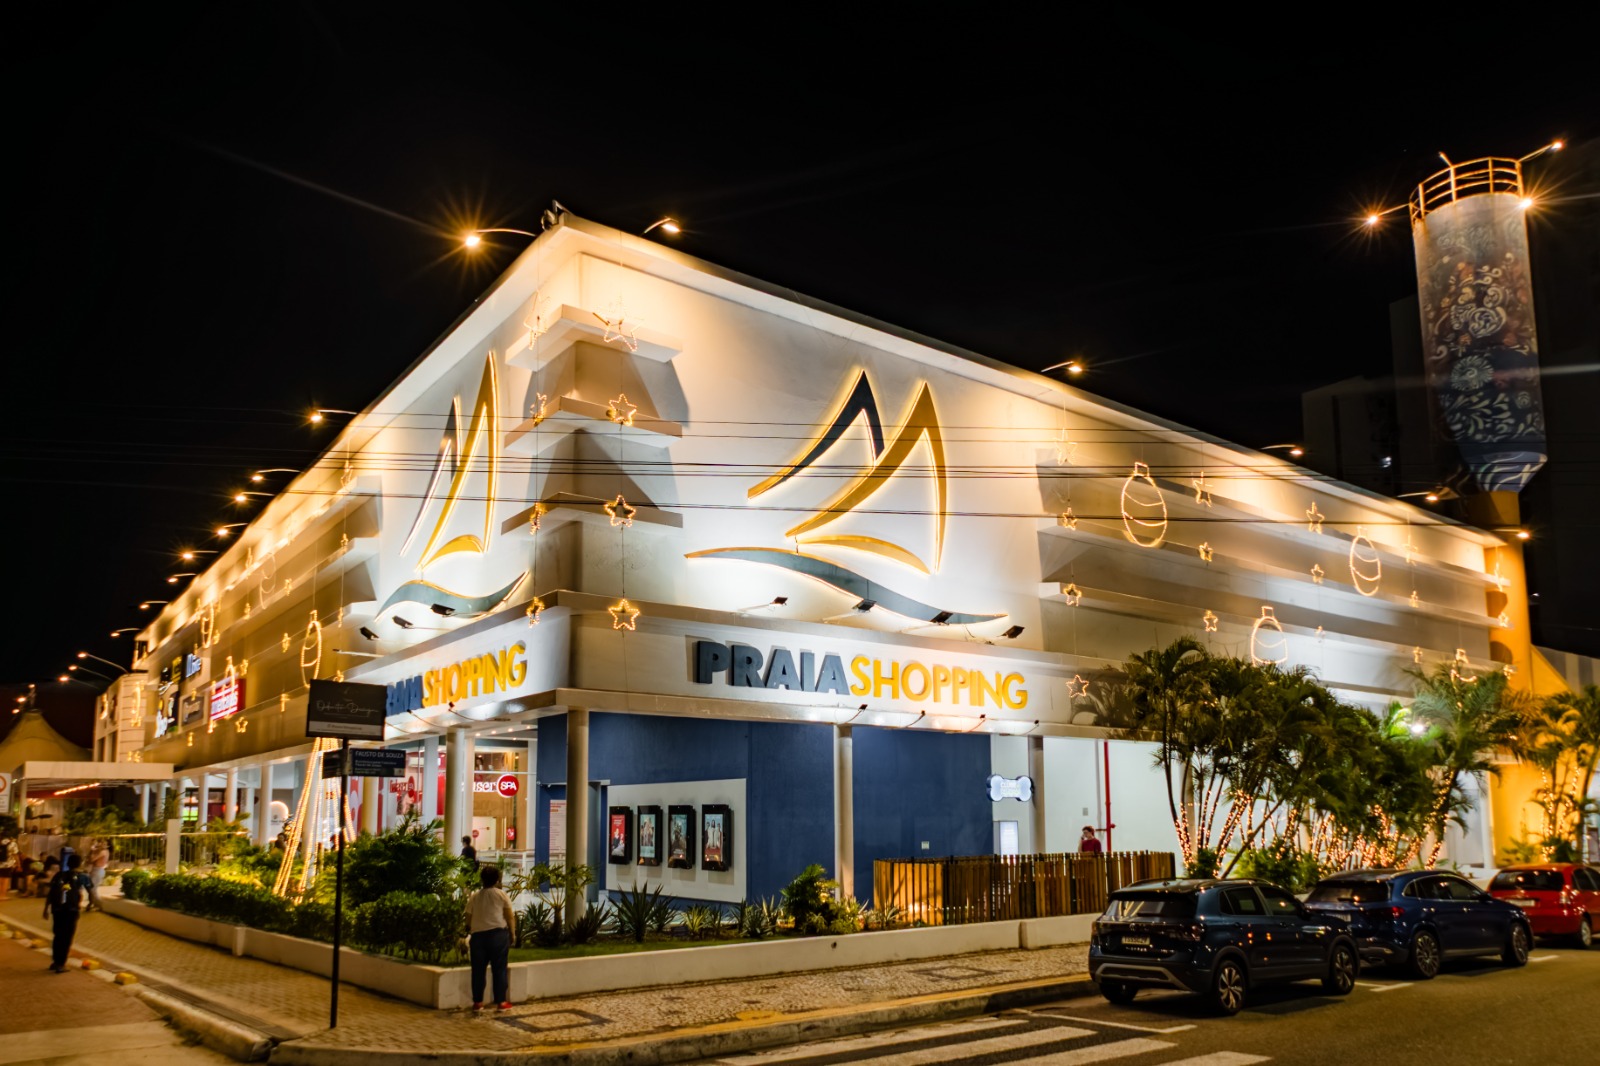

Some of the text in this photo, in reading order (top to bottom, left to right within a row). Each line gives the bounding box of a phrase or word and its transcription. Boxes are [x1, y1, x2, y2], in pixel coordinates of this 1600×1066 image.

[422, 643, 528, 708] SHOPPING
[695, 639, 1029, 710] PRAIA SHOPPING
[355, 750, 377, 758] FAUSTO
[500, 781, 517, 791] SPA
